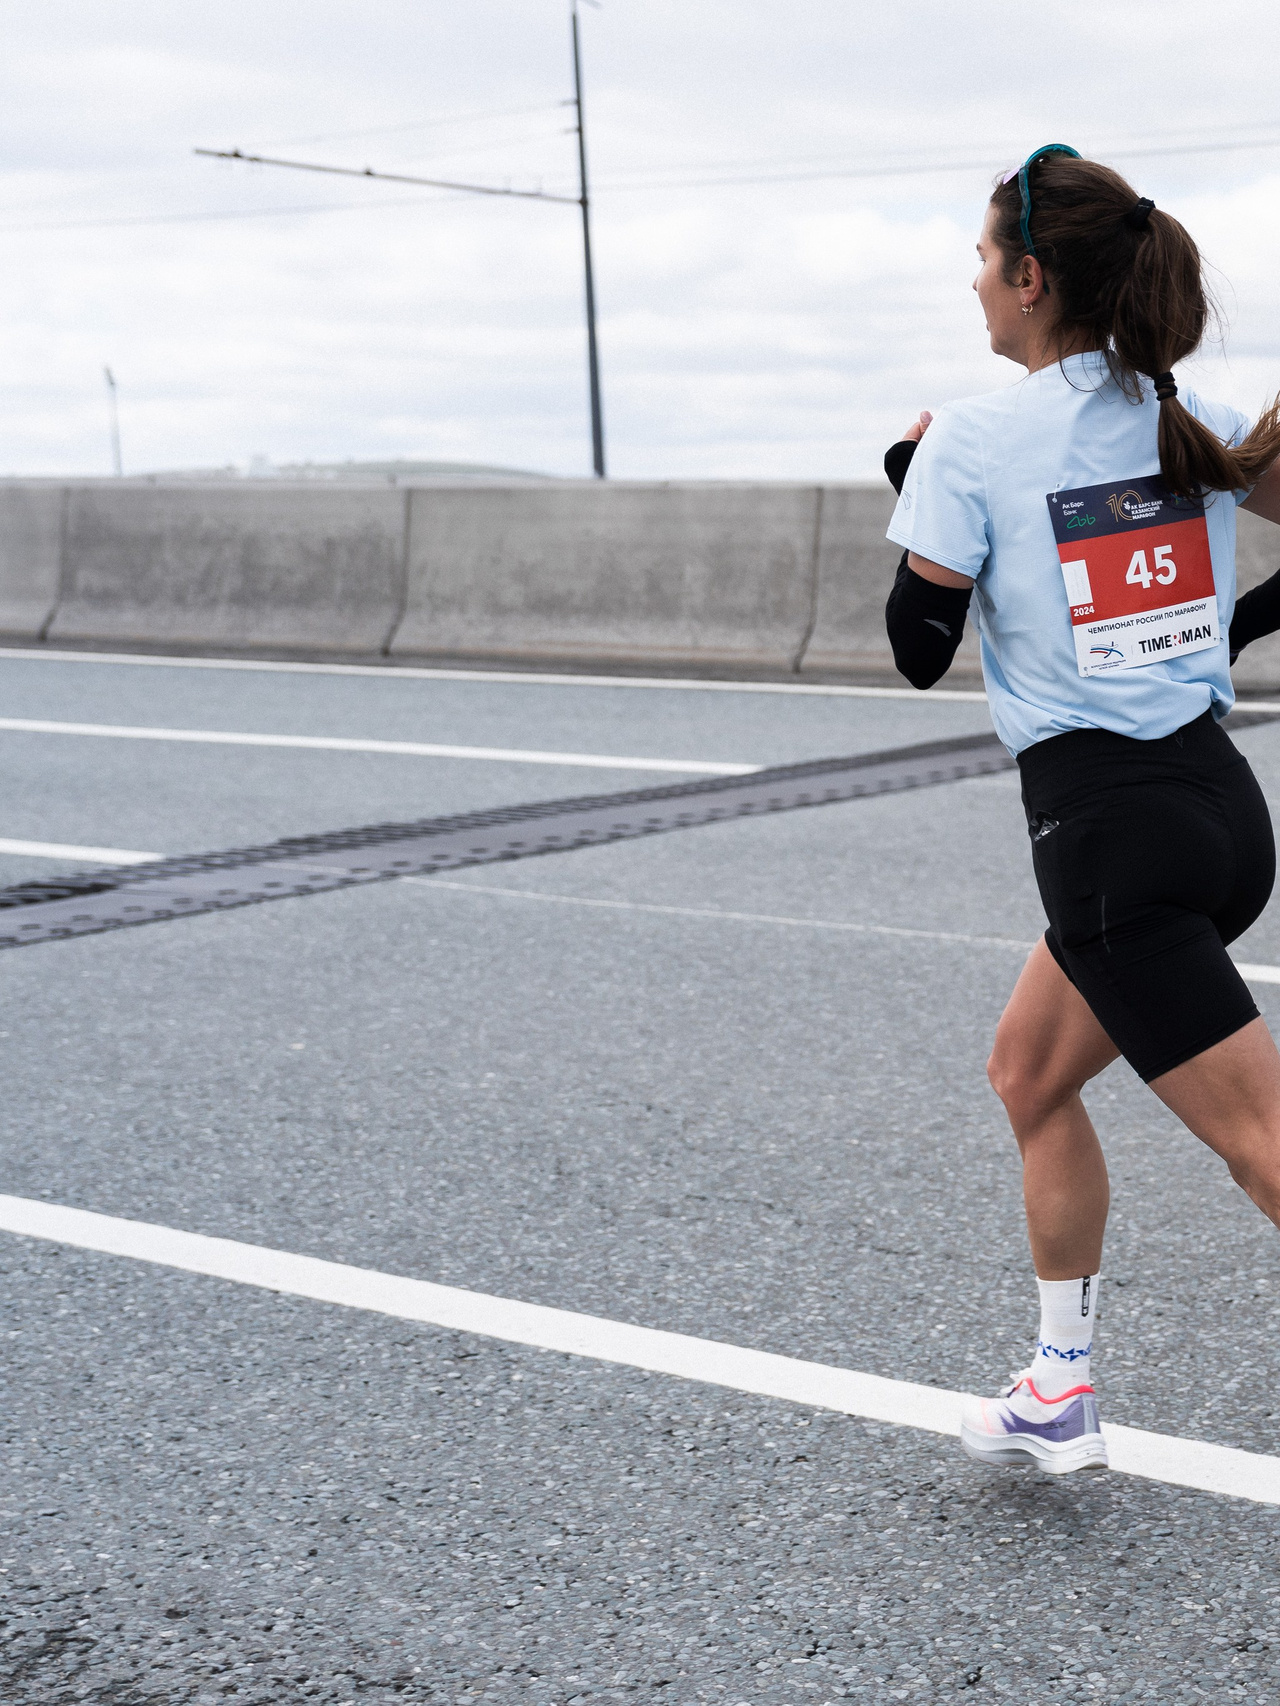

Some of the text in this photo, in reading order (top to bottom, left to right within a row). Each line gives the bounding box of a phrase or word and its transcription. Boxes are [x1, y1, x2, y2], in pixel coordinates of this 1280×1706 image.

[1125, 545, 1177, 589] 45
[1073, 605, 1095, 617] 2024
[1087, 603, 1207, 635] ЧЕМПИОНАТ РОССИИ ПО МАРАФОНУ
